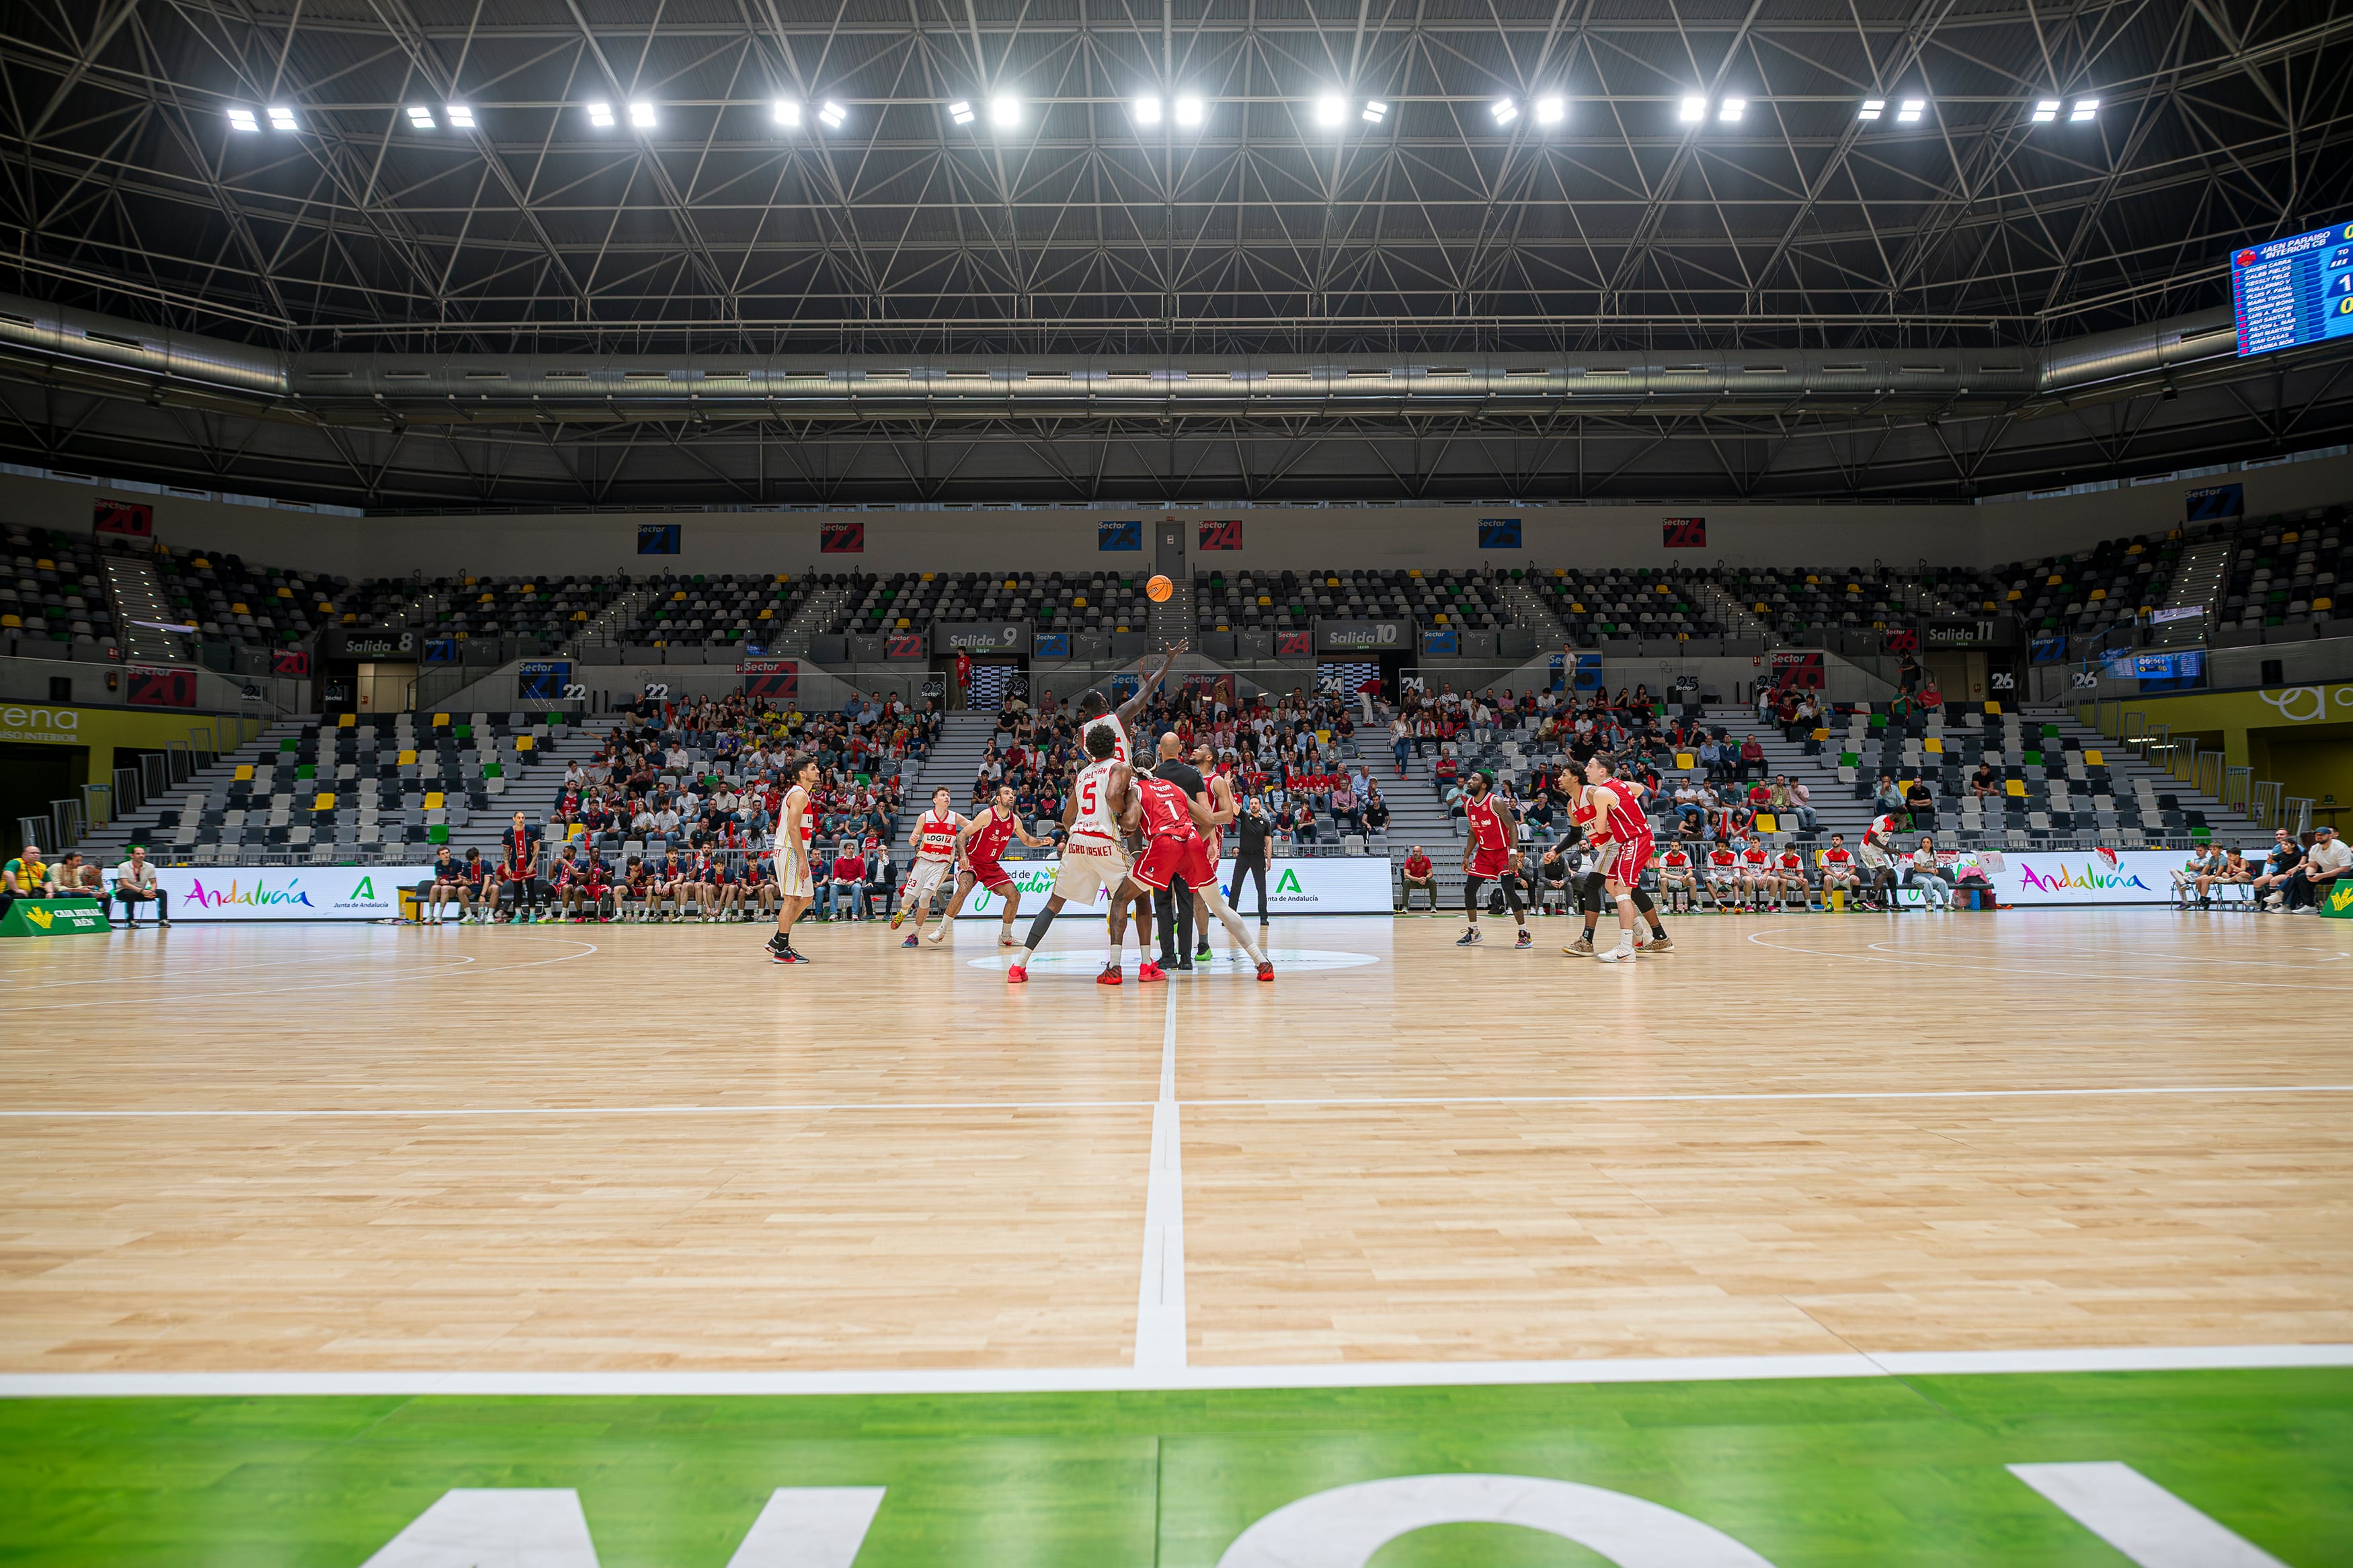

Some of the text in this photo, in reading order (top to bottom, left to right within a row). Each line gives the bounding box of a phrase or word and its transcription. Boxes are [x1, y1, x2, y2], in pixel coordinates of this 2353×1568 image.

[2260, 231, 2331, 255] JAEN PARAISO
[2265, 239, 2326, 259] INTERIOR CB
[2186, 489, 2221, 499] Sector
[2187, 483, 2241, 522] 27
[95, 499, 131, 511] Sector
[95, 503, 153, 537] 20
[638, 525, 666, 533] Sector
[821, 524, 848, 532] Sector
[1199, 521, 1226, 529] Sector
[638, 525, 678, 554] 21
[821, 523, 864, 552] 22
[1099, 521, 1142, 551] 23
[1199, 521, 1242, 550] 24
[1479, 519, 1521, 548] 25
[1663, 518, 1706, 547] 26
[951, 627, 1017, 646] Salida 9
[1330, 624, 1396, 643] Salida 10
[1886, 628, 1917, 651] 26
[1929, 621, 1993, 641] Salida 11
[346, 632, 413, 652] Salida 8
[426, 639, 454, 661] 21
[889, 634, 921, 657] 22
[1036, 634, 1068, 656] 23
[1278, 632, 1309, 654] 24
[1425, 631, 1456, 653] 25
[2032, 636, 2065, 661] 27
[274, 651, 309, 674] 20
[519, 662, 553, 672] Sector
[746, 662, 779, 671] Sector
[1771, 654, 1805, 663] Sector
[128, 666, 172, 676] Sector
[520, 662, 569, 699] 21
[746, 661, 798, 698] 22
[1112, 675, 1140, 685] Secto
[1183, 674, 1215, 684] Sector
[1772, 653, 1825, 690] 26
[1992, 673, 2014, 689] 26
[128, 666, 196, 707] 20
[563, 684, 585, 700] 22
[645, 684, 668, 700] 22
[921, 682, 945, 698] 23
[1004, 680, 1028, 696] 23
[1320, 677, 1343, 694] 24
[1402, 677, 1425, 693] 24
[1677, 675, 1699, 692] 25
[1757, 675, 1780, 689] 25
[1081, 781, 1096, 815] 5
[1164, 800, 1179, 821] 1
[908, 878, 917, 888] 23
[1007, 870, 1031, 878] ed de
[2019, 861, 2152, 893] Andalucía
[184, 877, 316, 909] Andalucía
